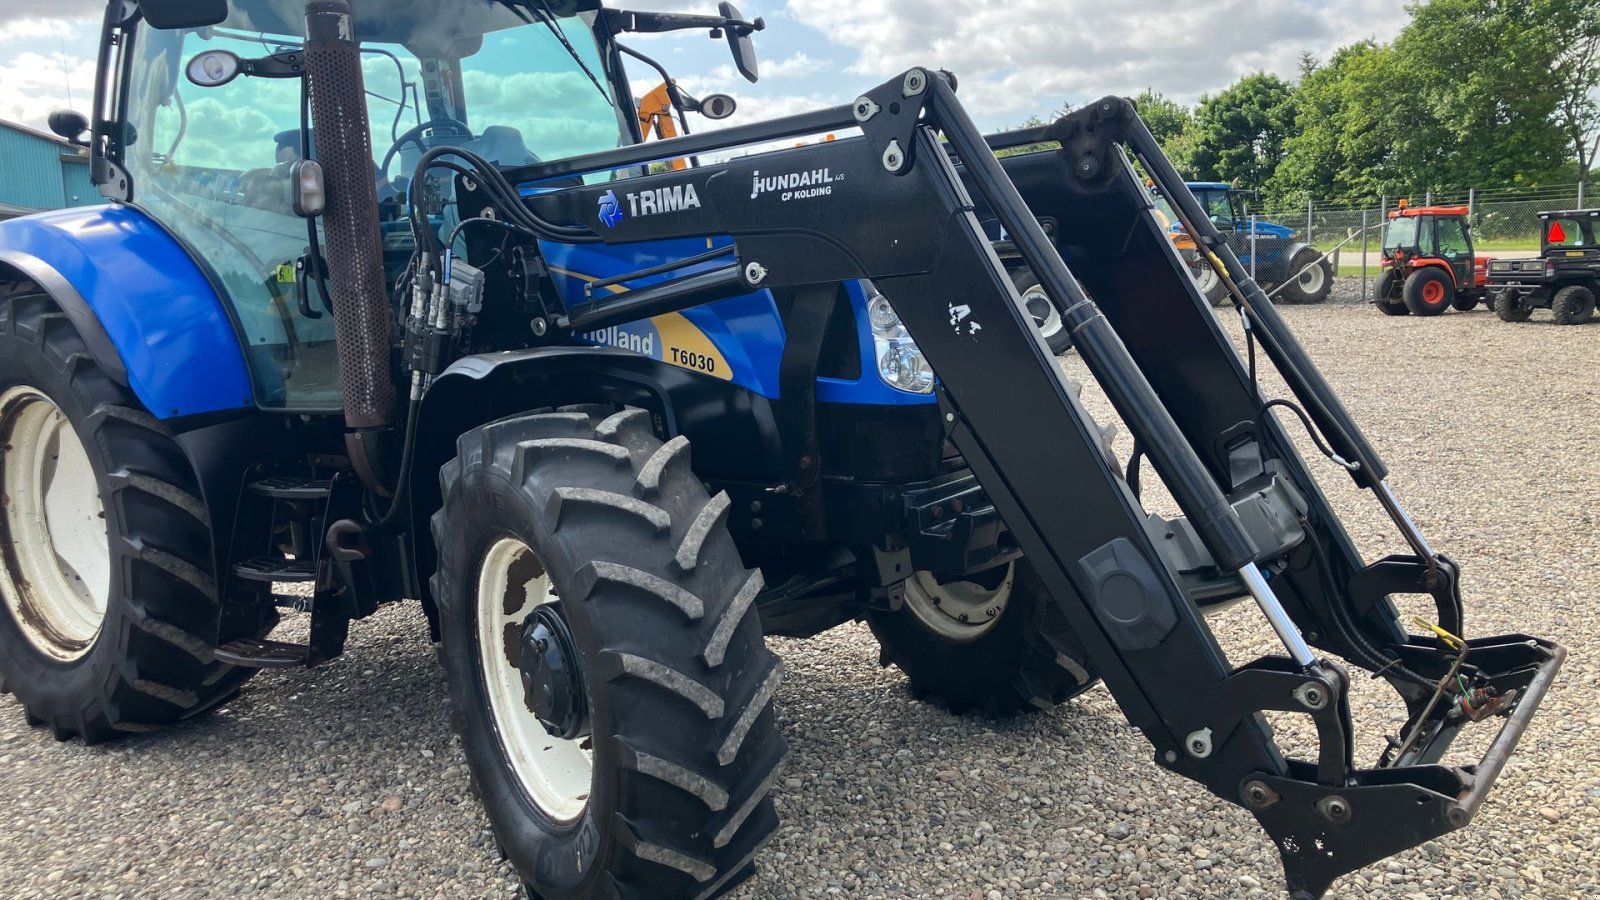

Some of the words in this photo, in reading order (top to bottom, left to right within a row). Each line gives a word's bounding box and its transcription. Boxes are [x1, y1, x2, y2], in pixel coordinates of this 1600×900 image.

[626, 183, 701, 217] TRIMA
[781, 192, 793, 202] CP
[794, 186, 832, 199] KOLDING
[671, 347, 715, 373] T6030
